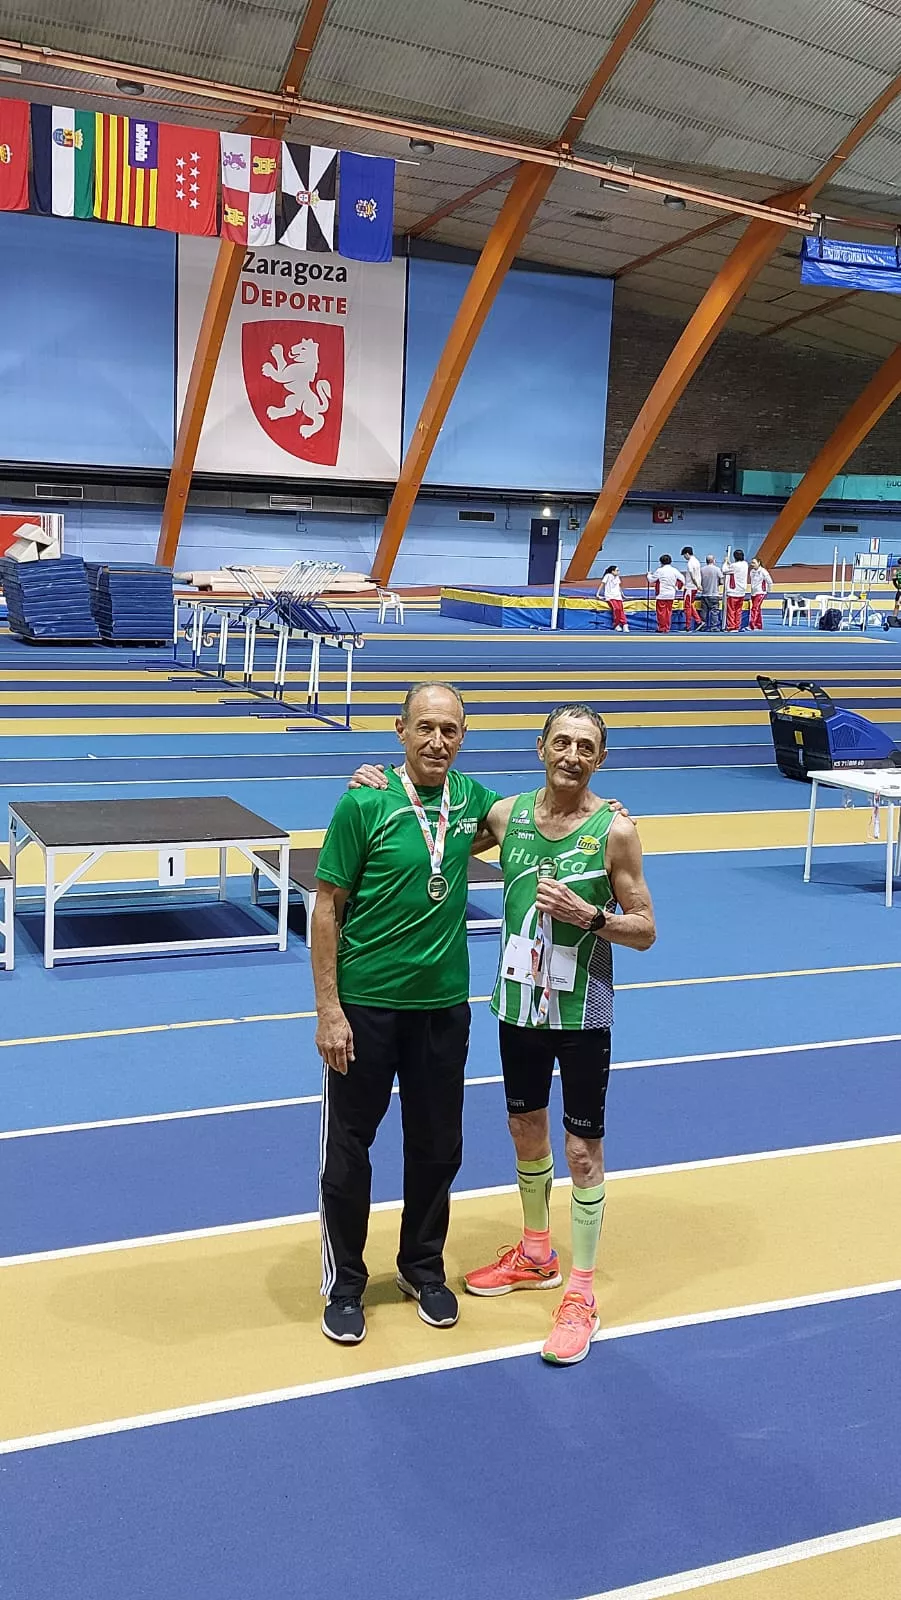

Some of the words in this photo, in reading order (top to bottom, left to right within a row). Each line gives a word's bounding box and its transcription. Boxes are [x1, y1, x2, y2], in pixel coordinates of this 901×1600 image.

[242, 251, 347, 285] Zaragoza
[241, 281, 347, 314] DEPORTE
[863, 569, 886, 581] 176
[167, 856, 174, 877] 1
